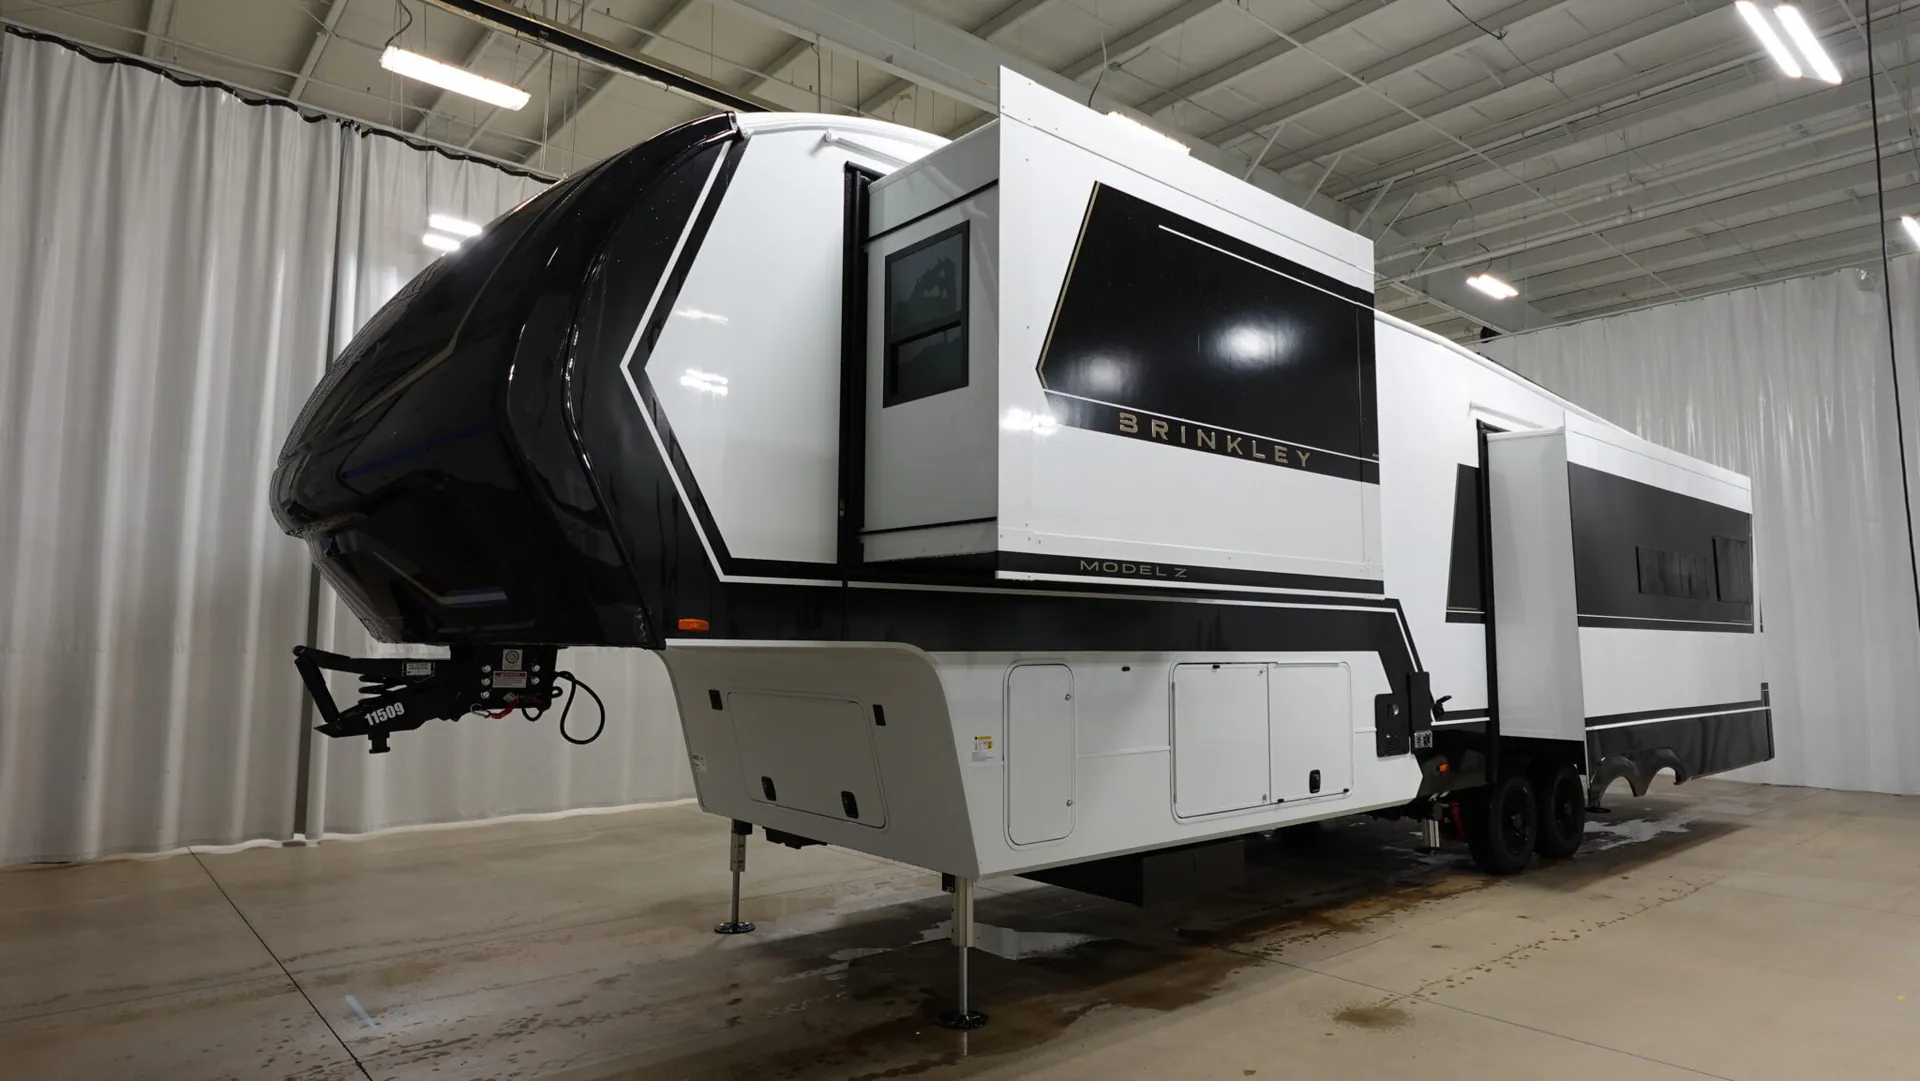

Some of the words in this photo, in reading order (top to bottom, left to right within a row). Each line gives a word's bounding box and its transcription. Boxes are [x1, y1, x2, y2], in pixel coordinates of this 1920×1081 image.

[1119, 412, 1311, 468] BRINKLEY
[1080, 560, 1167, 577] MODEL
[1174, 567, 1188, 578] Z
[364, 702, 405, 726] 11509
